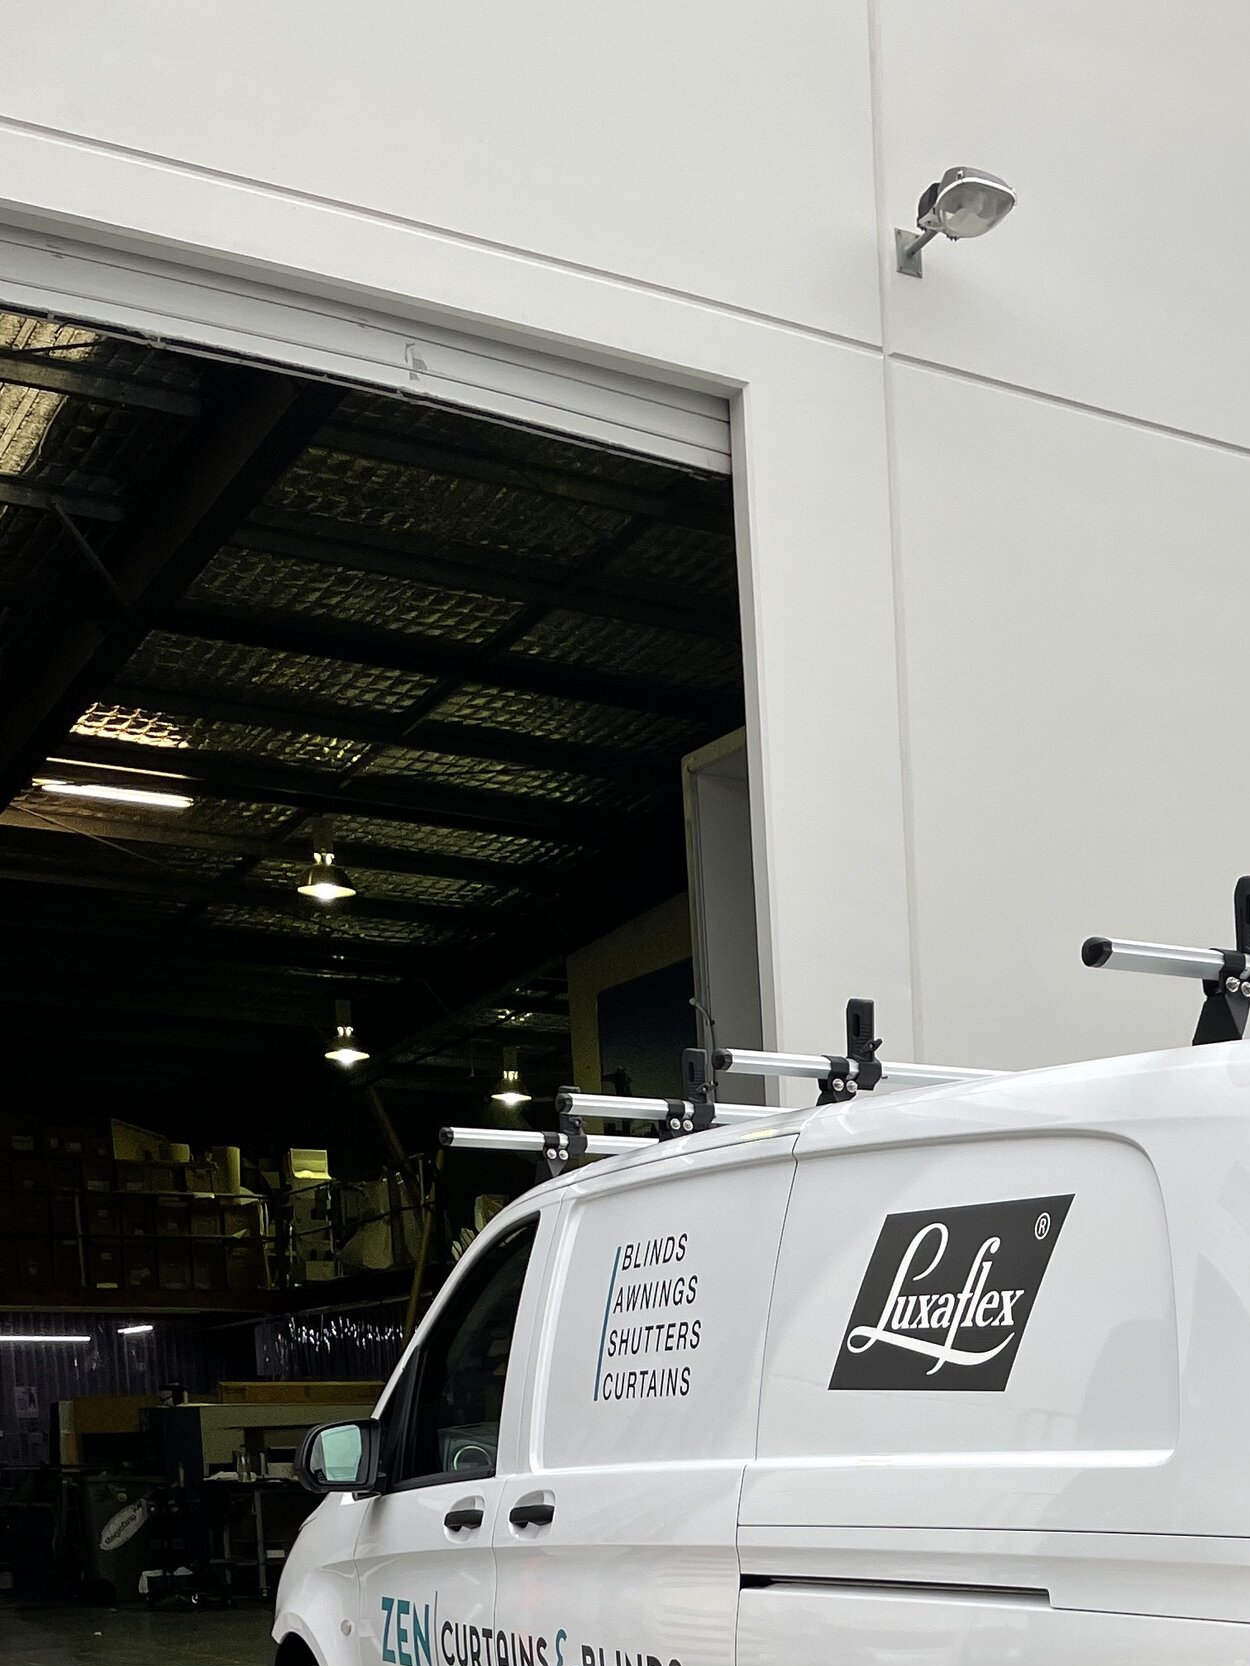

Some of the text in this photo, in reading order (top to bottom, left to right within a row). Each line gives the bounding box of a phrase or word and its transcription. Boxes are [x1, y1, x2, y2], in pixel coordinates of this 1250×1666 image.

[622, 1233, 687, 1271] BLINDS
[613, 1275, 698, 1314] AWNINGS
[846, 1222, 1025, 1375] Luxaflex
[608, 1319, 701, 1357] SHUTTERS
[602, 1366, 691, 1401] CURTAINS
